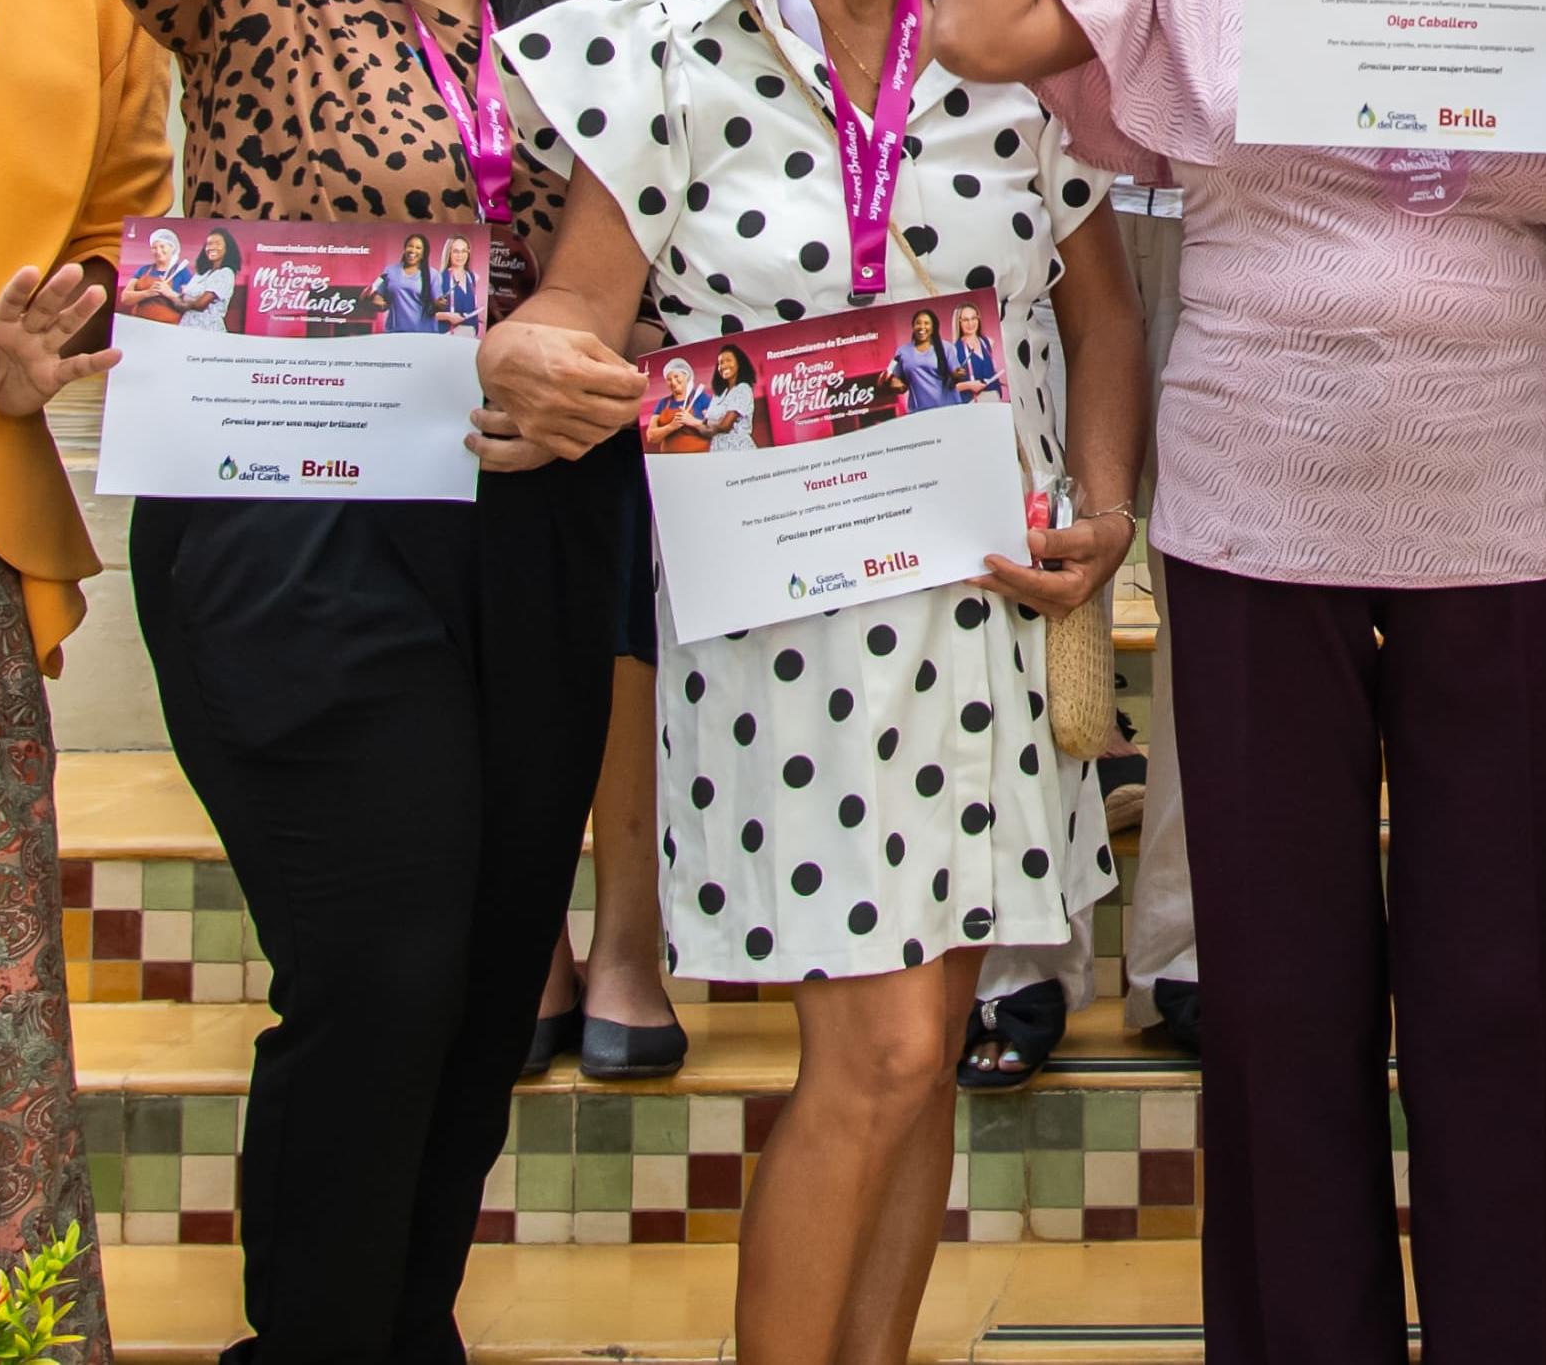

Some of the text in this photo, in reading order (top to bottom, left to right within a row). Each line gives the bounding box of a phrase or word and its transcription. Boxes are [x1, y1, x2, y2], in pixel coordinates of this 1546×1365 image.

[901, 11, 917, 50] Mujeres
[1388, 15, 1478, 29] Olga Caballero
[1388, 111, 1416, 121] Gases
[1439, 108, 1496, 128] Brilla
[1378, 121, 1427, 131] del Caribe
[880, 130, 897, 173] Mujeres
[281, 261, 321, 275] Premio
[254, 267, 330, 296] Mujeres
[259, 290, 356, 315] Brillantes
[794, 361, 834, 377] Premio
[252, 373, 345, 386] Sissi Contreras
[771, 370, 844, 399] Mujeres
[781, 384, 875, 421] Brillantes
[250, 463, 279, 472] Gases
[302, 460, 359, 478] Brilla
[239, 472, 290, 482] del Caribe
[804, 469, 868, 492] Yanet Lara
[776, 507, 912, 545] ¡Gracias por ser una mujer brillante!
[864, 552, 919, 577] Brilla
[816, 572, 845, 584] Gases
[809, 579, 857, 596] del Caribe
